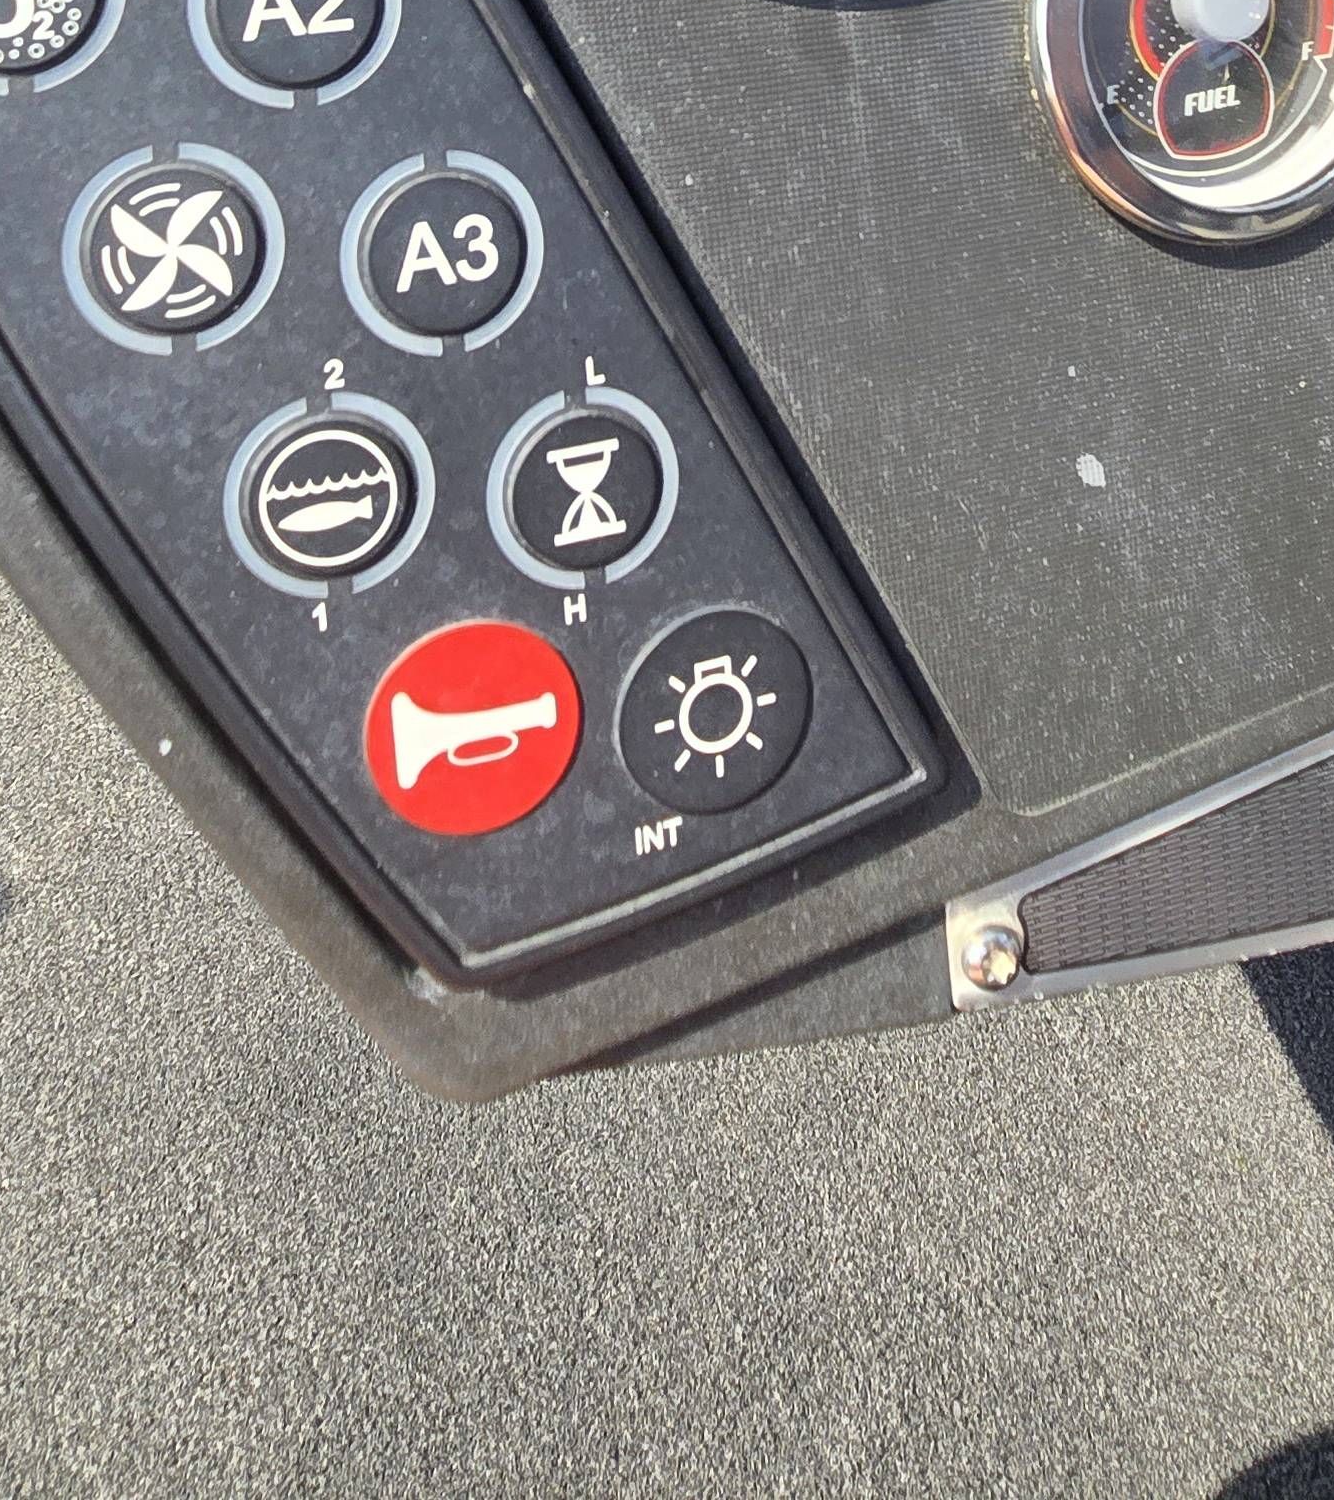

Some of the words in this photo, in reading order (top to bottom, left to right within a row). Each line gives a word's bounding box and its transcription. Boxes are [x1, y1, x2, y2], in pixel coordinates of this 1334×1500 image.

[1302, 41, 1315, 61] F
[1106, 85, 1120, 104] E
[1184, 85, 1241, 116] FUEL
[396, 212, 500, 294] A3
[321, 358, 347, 390] 2
[584, 356, 606, 386] L
[310, 602, 328, 632] 1
[563, 594, 588, 626] H
[634, 818, 685, 856] INT
